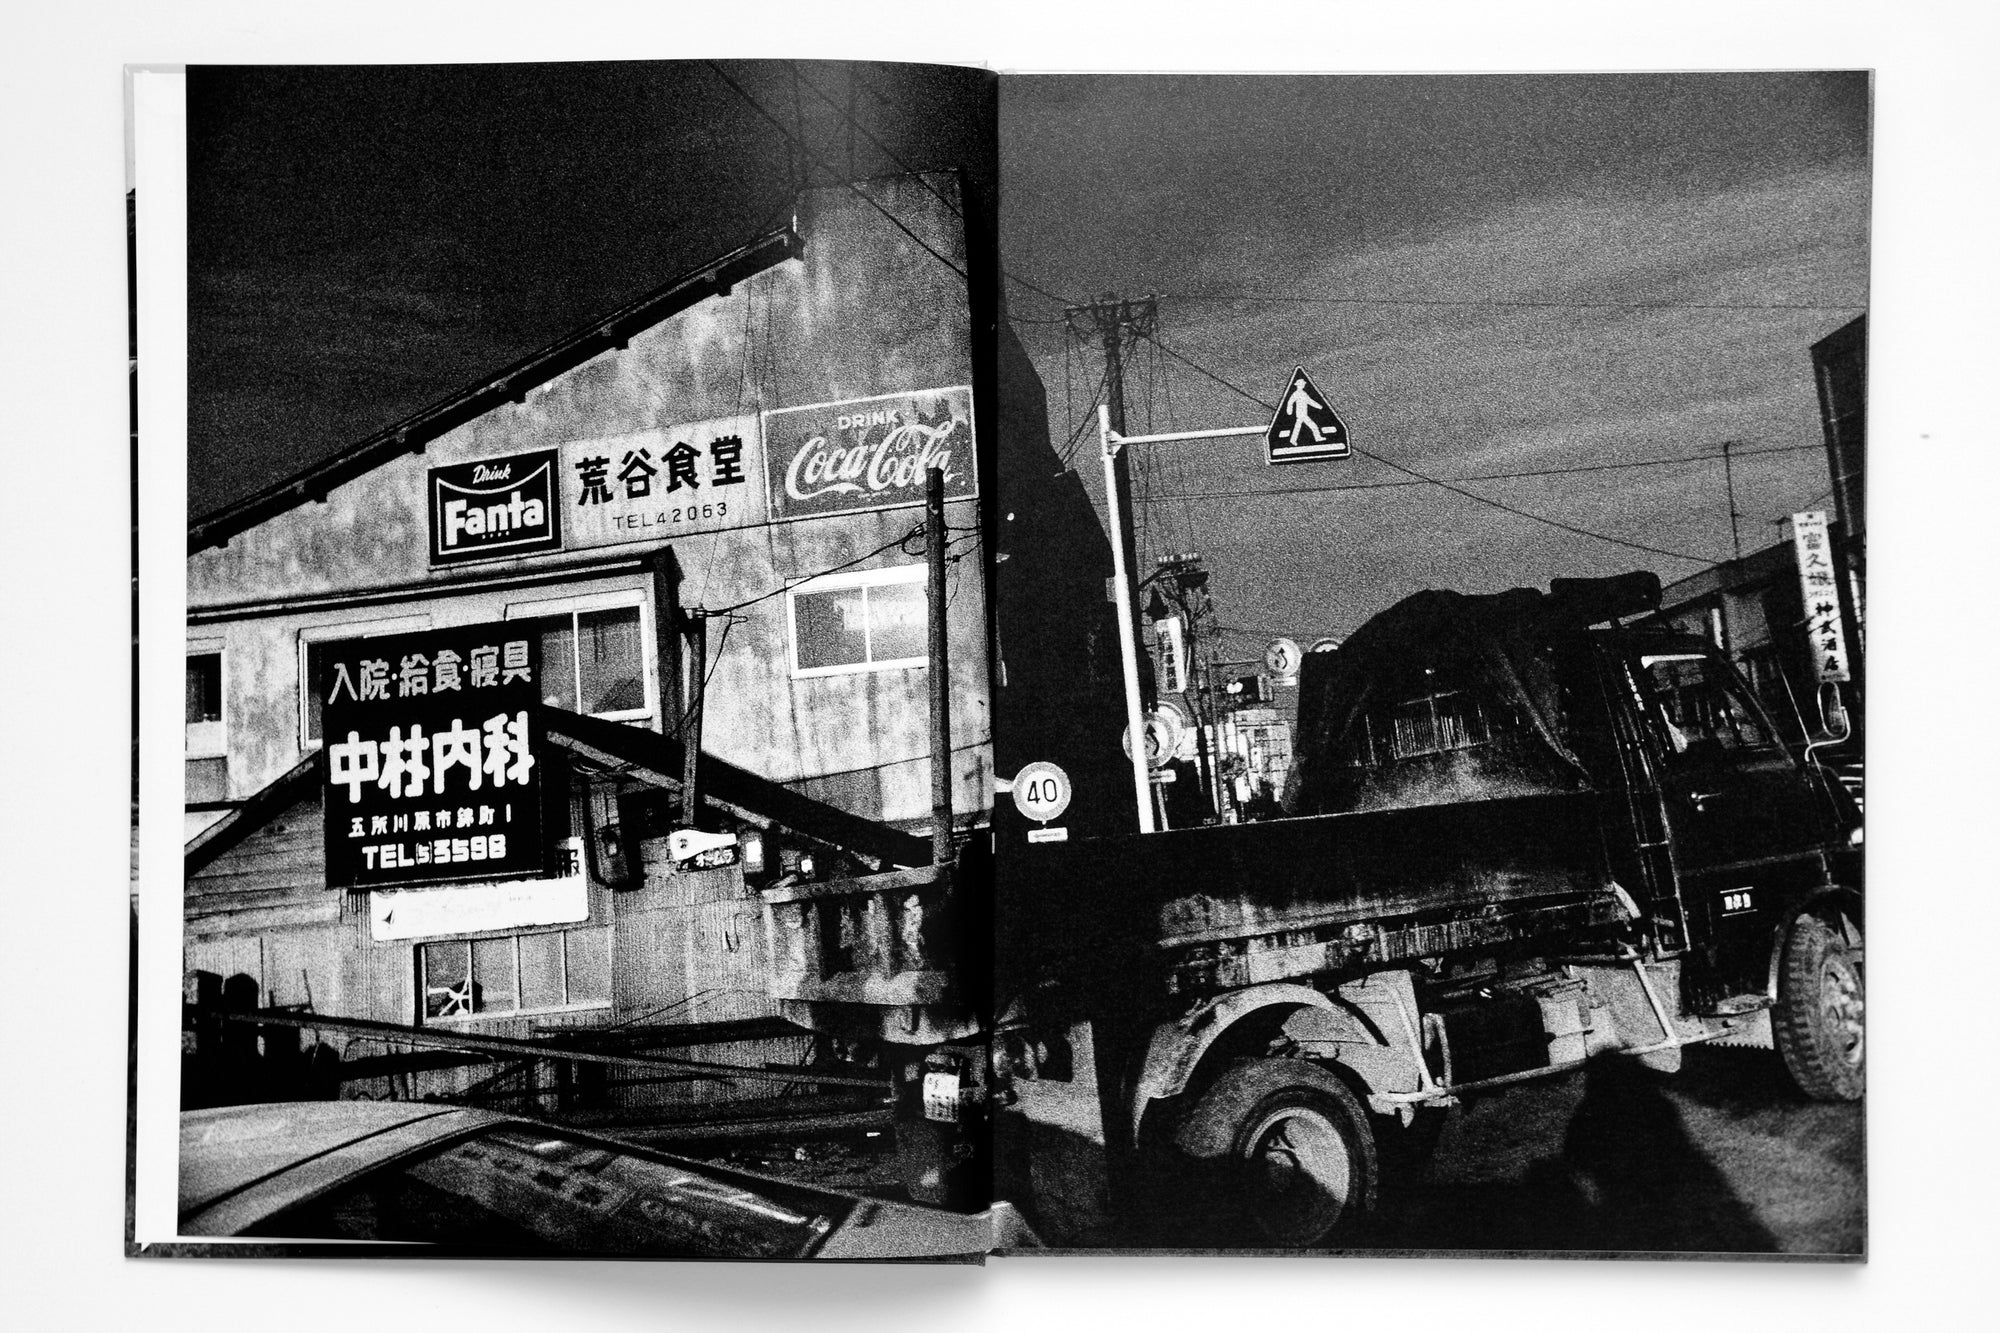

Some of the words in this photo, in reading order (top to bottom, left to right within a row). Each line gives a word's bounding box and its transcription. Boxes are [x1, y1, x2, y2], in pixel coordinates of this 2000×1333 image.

[837, 409, 900, 430] DRINK
[472, 462, 512, 485] Drink
[574, 434, 746, 506] 荒谷食堂
[785, 416, 967, 501] Coca-Cola
[444, 490, 545, 547] Fanta
[328, 710, 536, 804] 中村内科
[1027, 778, 1058, 804] 40
